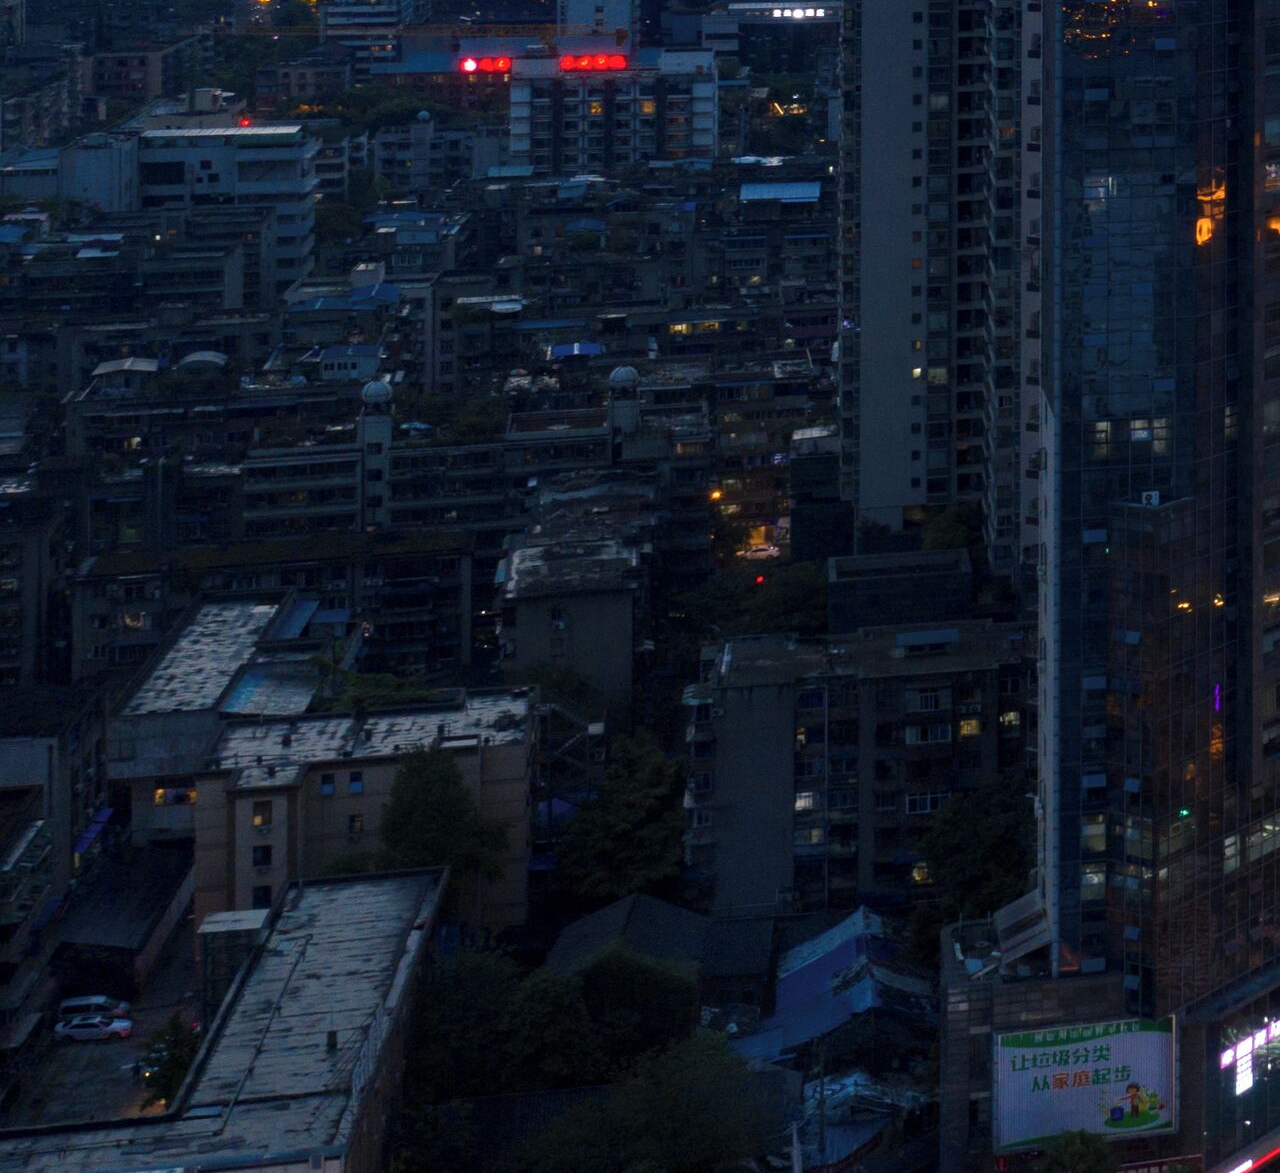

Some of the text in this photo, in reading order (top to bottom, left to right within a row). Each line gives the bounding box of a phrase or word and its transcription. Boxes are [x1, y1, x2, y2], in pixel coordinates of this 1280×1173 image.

[1010, 1044, 1112, 1072] 让垃圾分类
[1031, 1065, 1132, 1093] 从家庭起步
